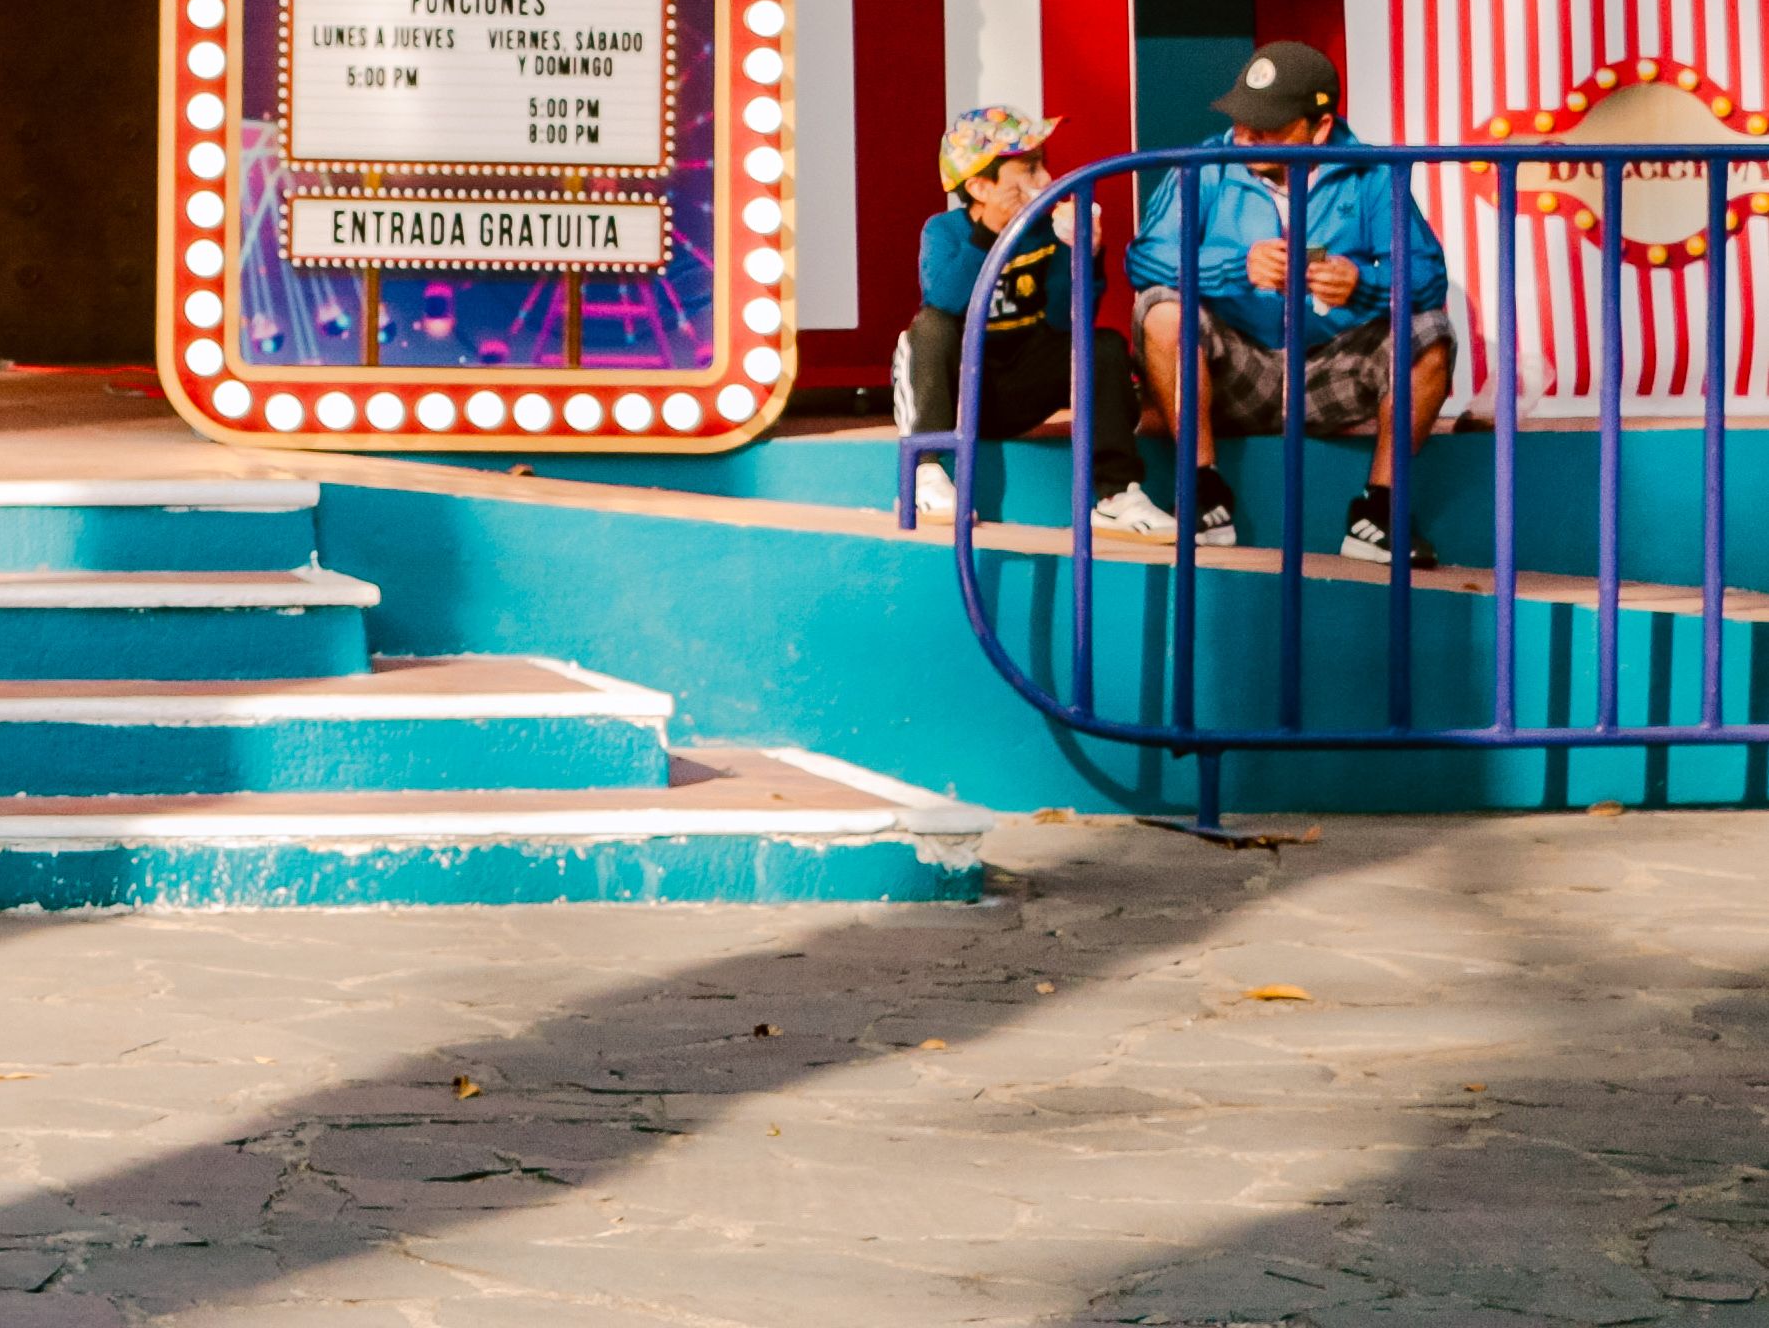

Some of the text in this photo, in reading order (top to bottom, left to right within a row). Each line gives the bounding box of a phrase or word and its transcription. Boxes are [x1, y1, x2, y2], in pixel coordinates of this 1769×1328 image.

[313, 26, 455, 50] LUNES A JUEVES
[487, 26, 644, 55] VIERNES, SÁBADO
[346, 65, 418, 88] 5:00 PM
[518, 55, 613, 78] Y DOMINGO
[529, 97, 600, 119] 5:00 PM
[528, 123, 600, 145] 8:00 PM
[333, 210, 619, 249] ENTRADA GRATUITA
